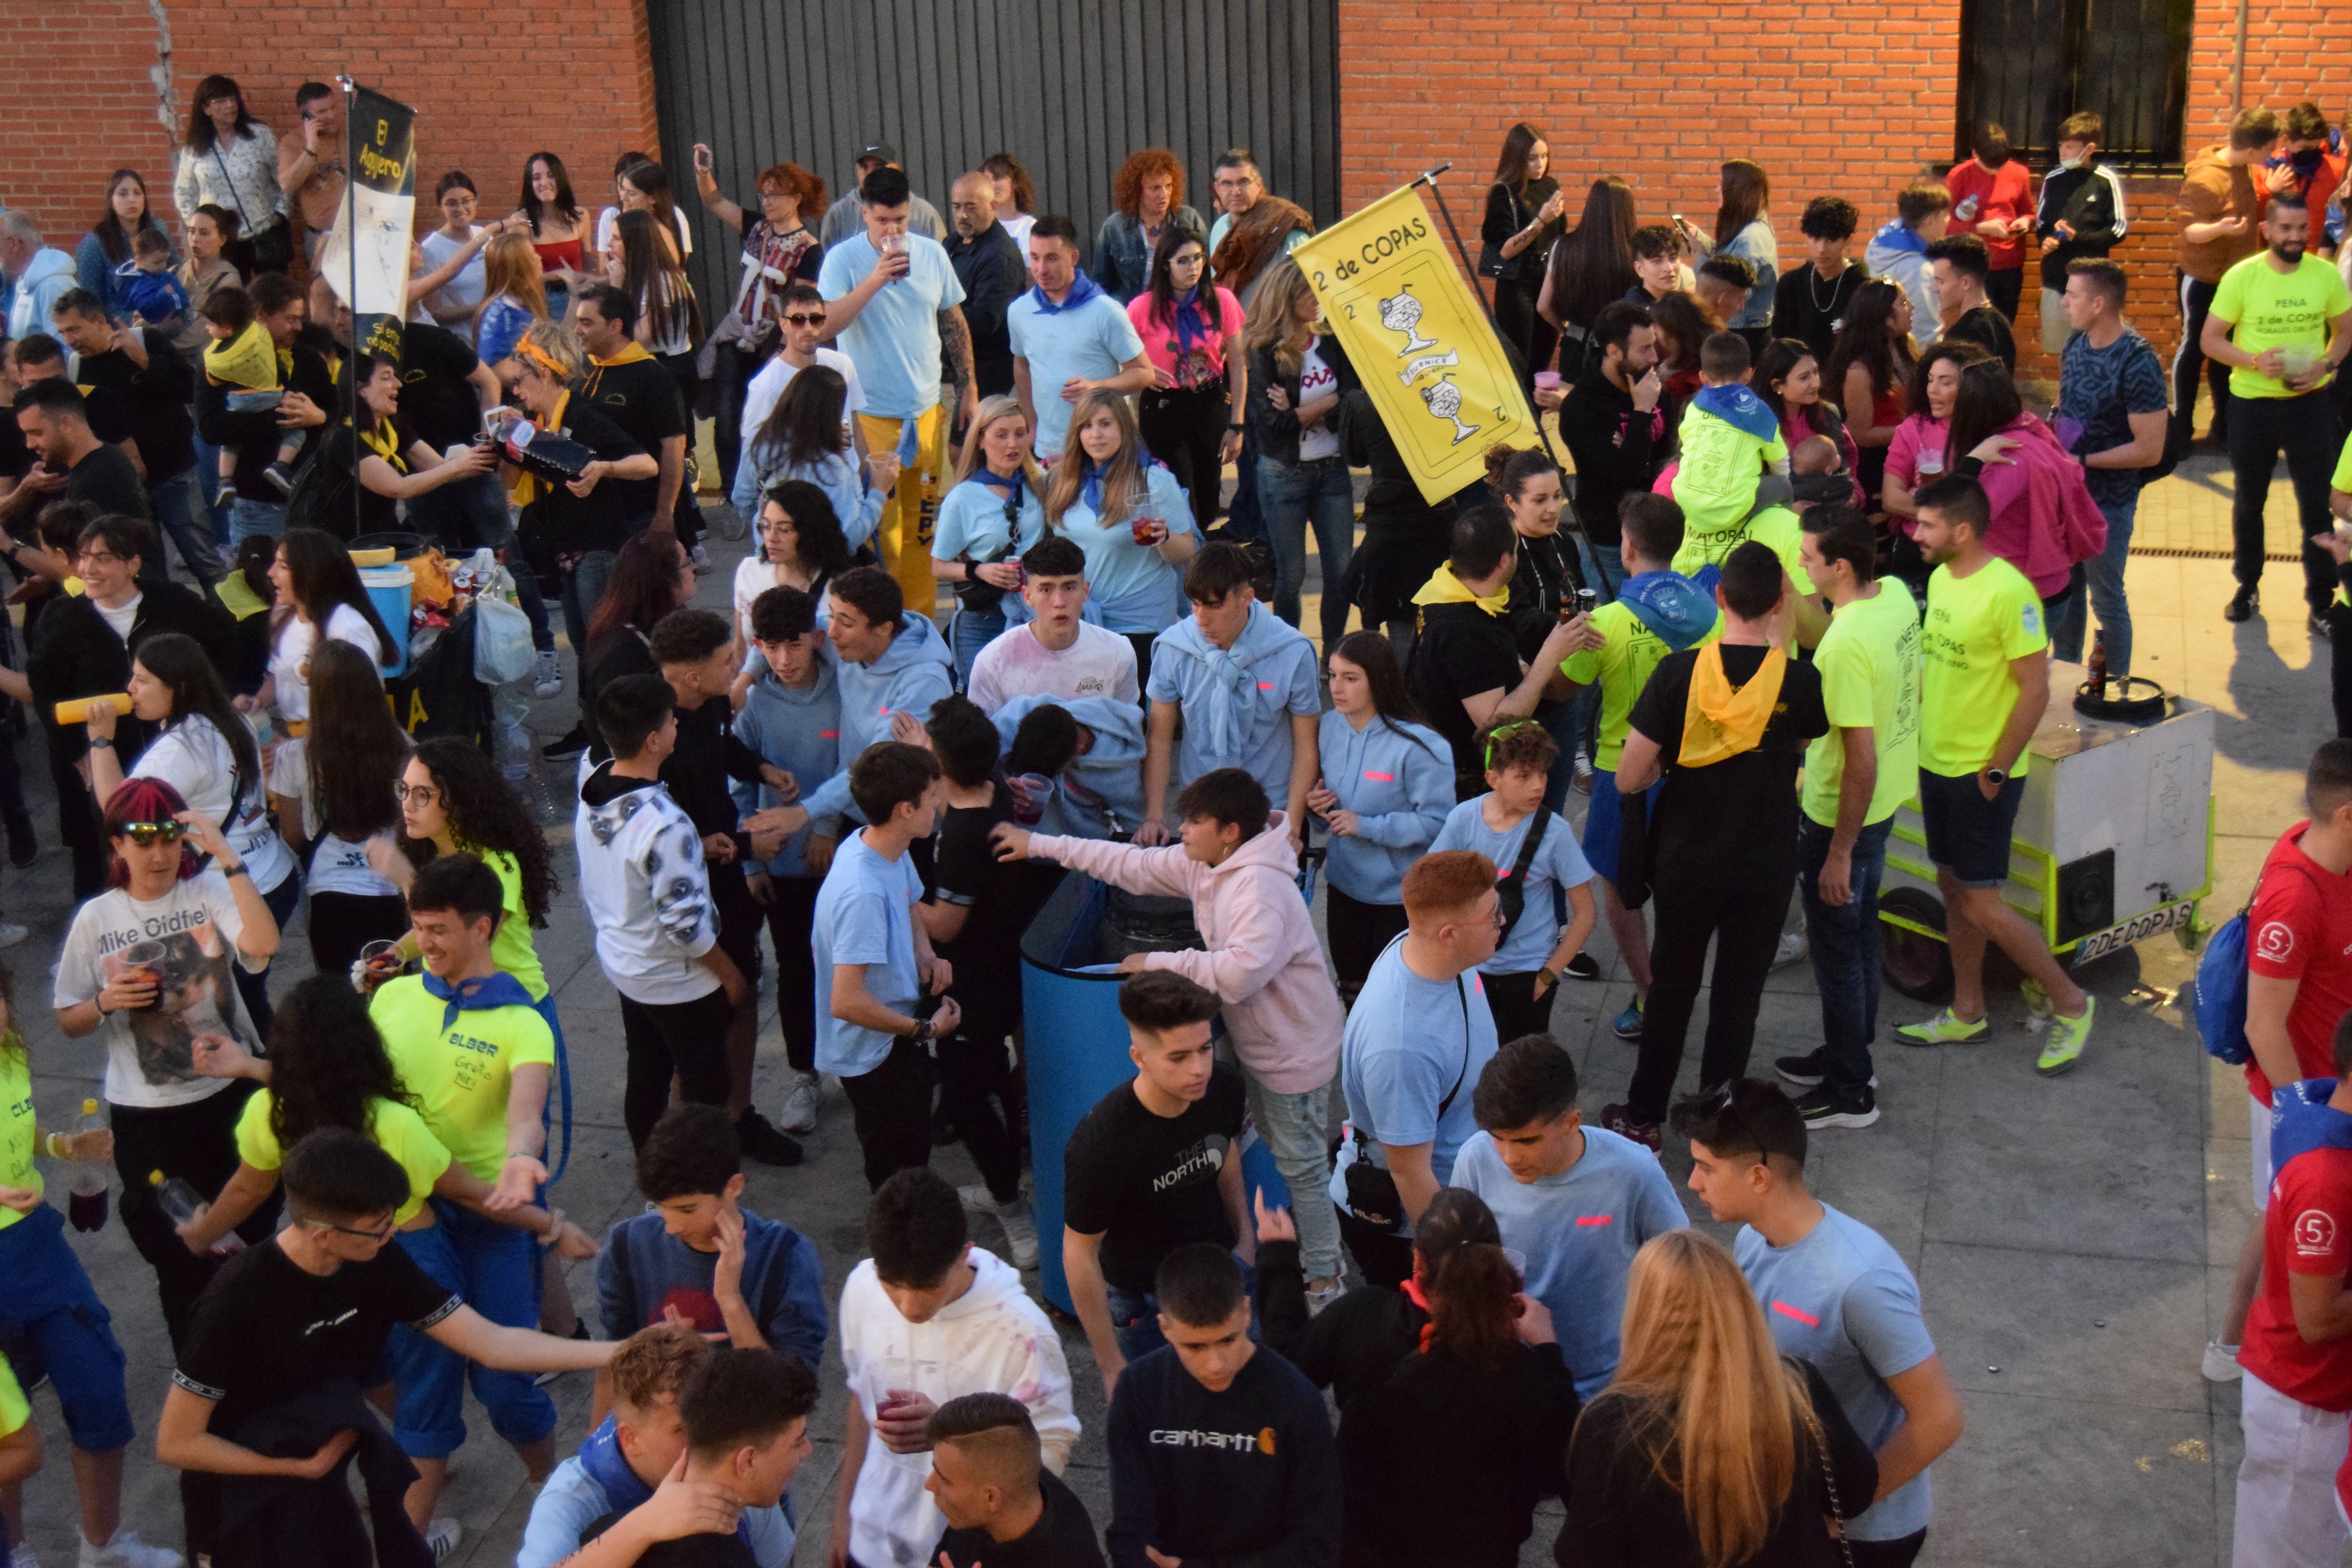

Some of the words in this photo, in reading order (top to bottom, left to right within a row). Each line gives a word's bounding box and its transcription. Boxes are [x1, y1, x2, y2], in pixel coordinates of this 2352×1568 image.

[377, 119, 388, 146] El
[1313, 270, 1328, 292] 2
[1335, 260, 1360, 281] de
[1361, 217, 1426, 265] COPAS
[1344, 304, 1357, 320] 2
[2275, 297, 2307, 309] PEÑA
[2257, 316, 2264, 325] 2
[2268, 315, 2282, 324] de
[99, 929, 139, 955] Mike
[2266, 929, 2283, 950] 5
[1175, 1139, 1205, 1165] THE
[1153, 1151, 1208, 1192] NORTH
[2306, 1219, 2322, 1243] 5
[1149, 1429, 1257, 1452] carhartt
